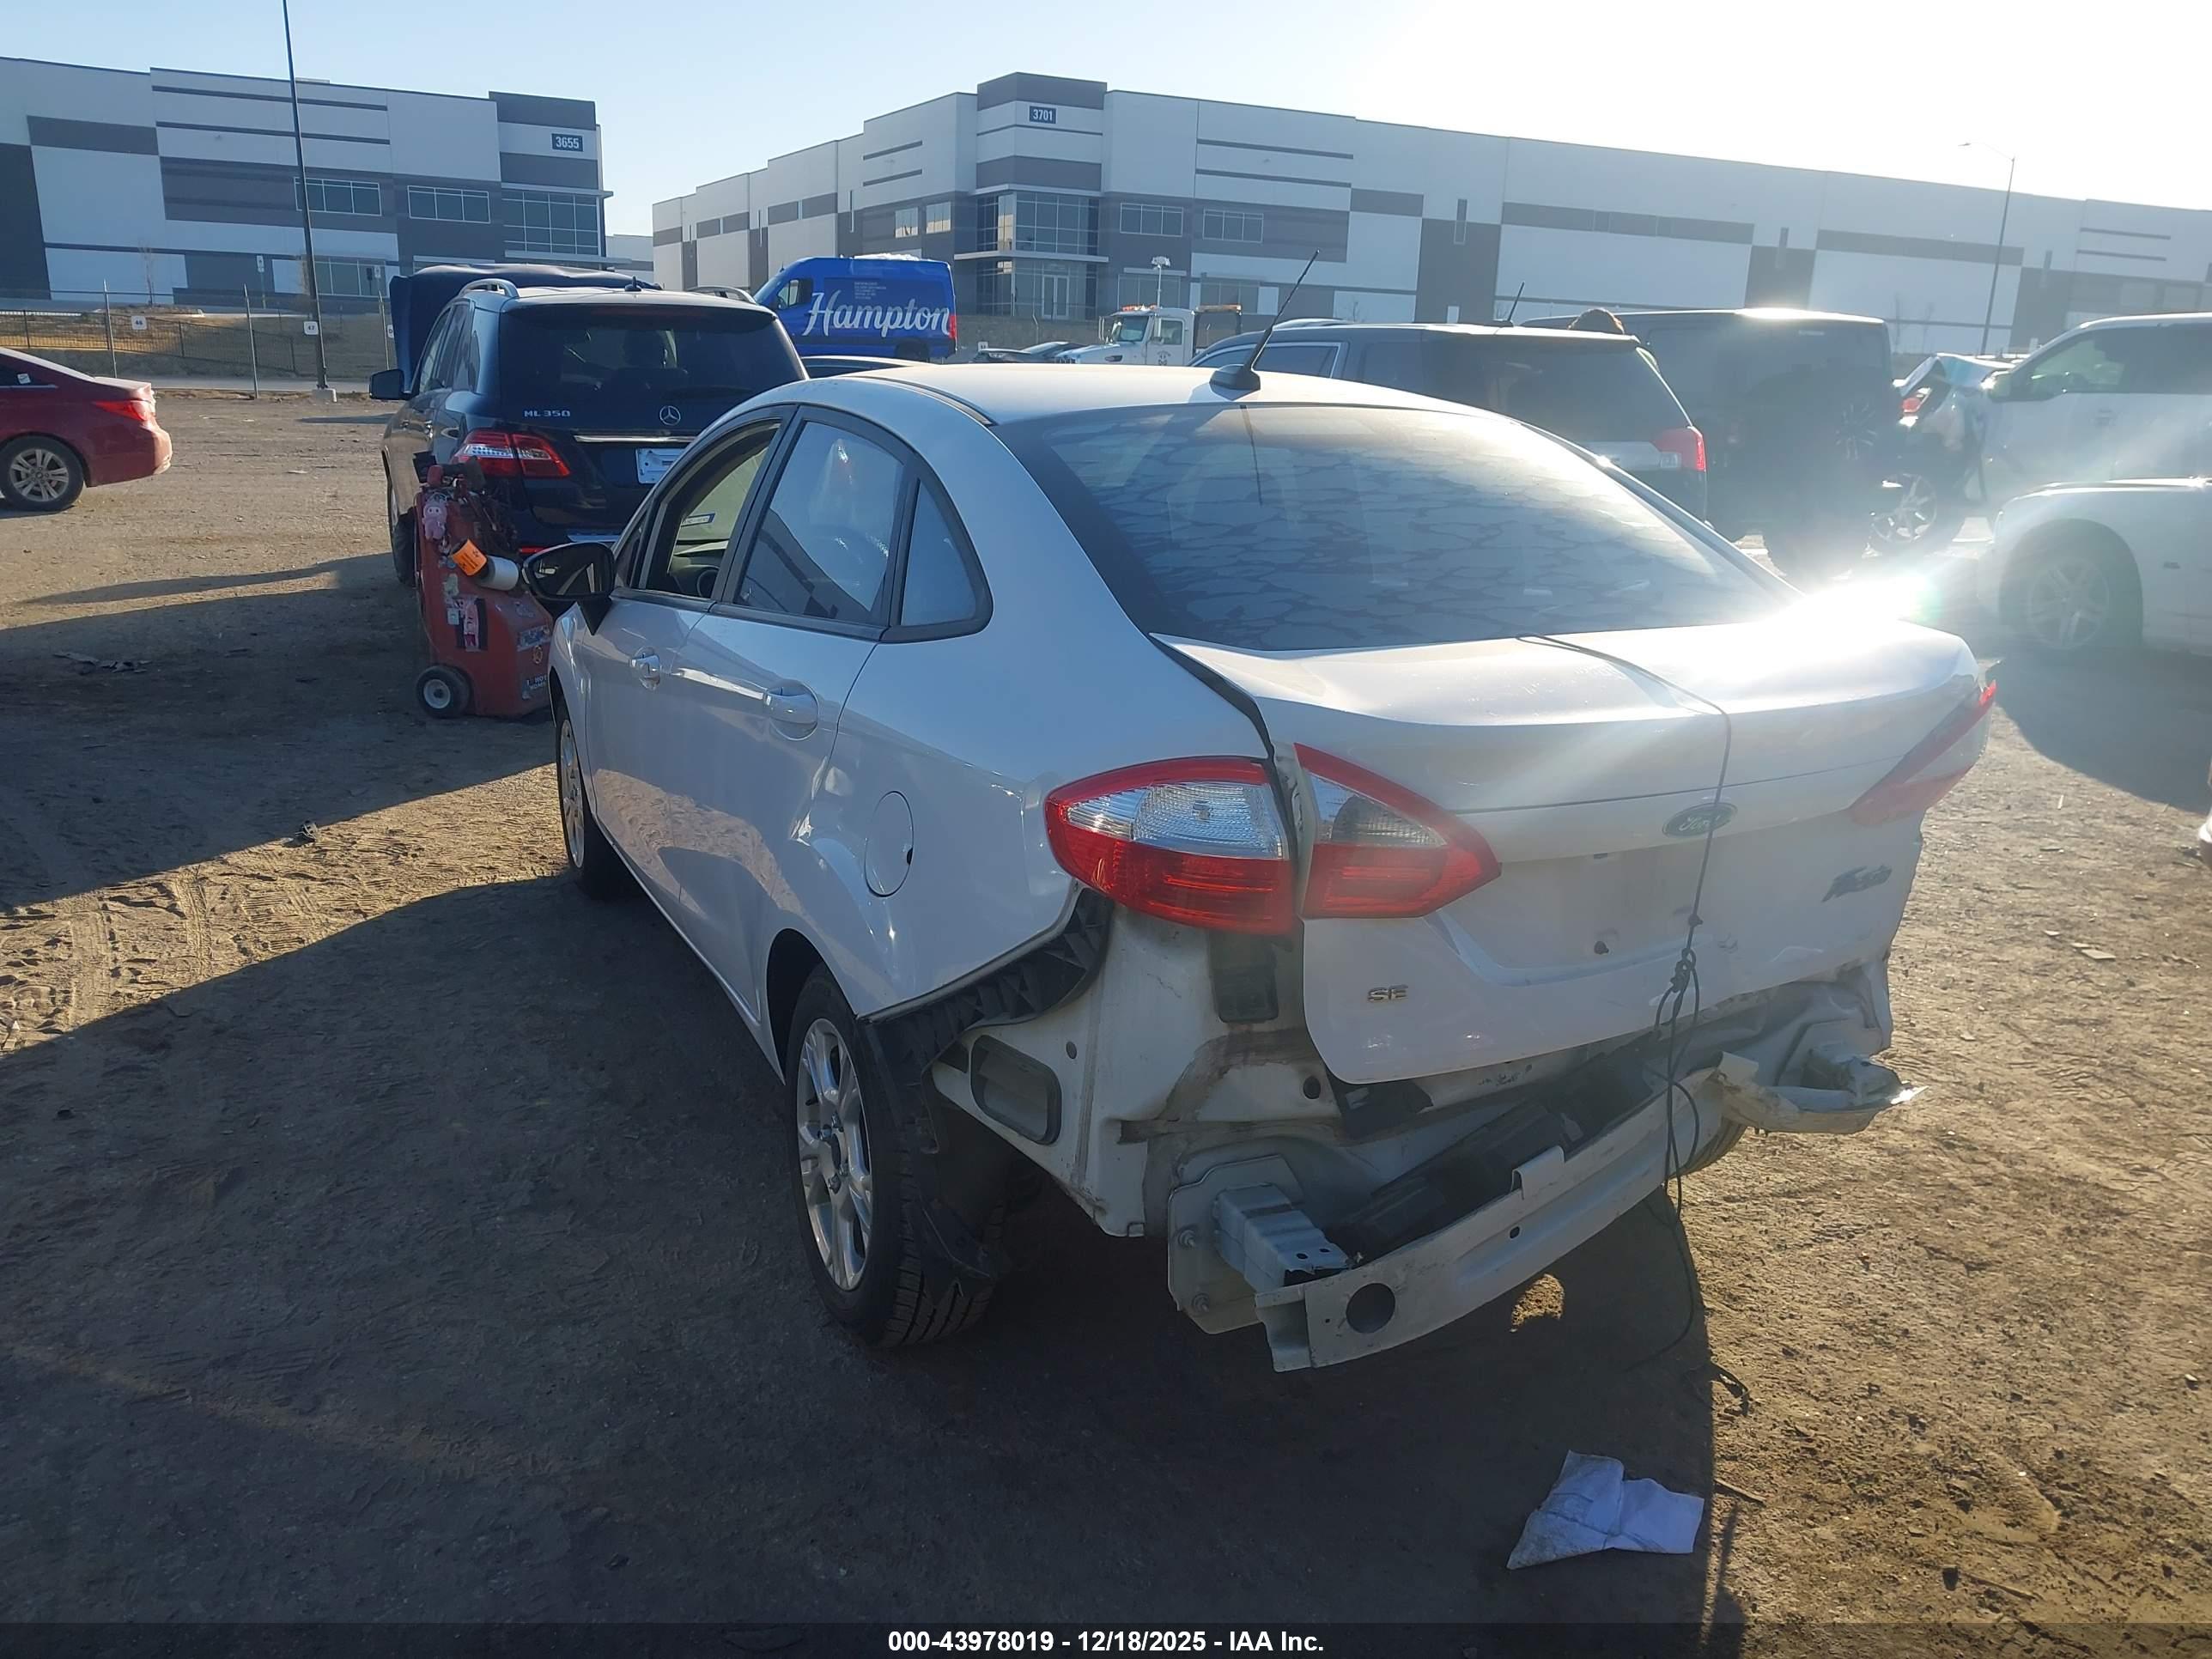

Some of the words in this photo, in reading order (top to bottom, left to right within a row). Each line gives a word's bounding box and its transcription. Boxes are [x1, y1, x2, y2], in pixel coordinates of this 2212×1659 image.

[1033, 109, 1053, 121] 3701
[556, 137, 580, 149] 3655
[802, 289, 950, 337] Hampton
[1367, 987, 1407, 1003] SE
